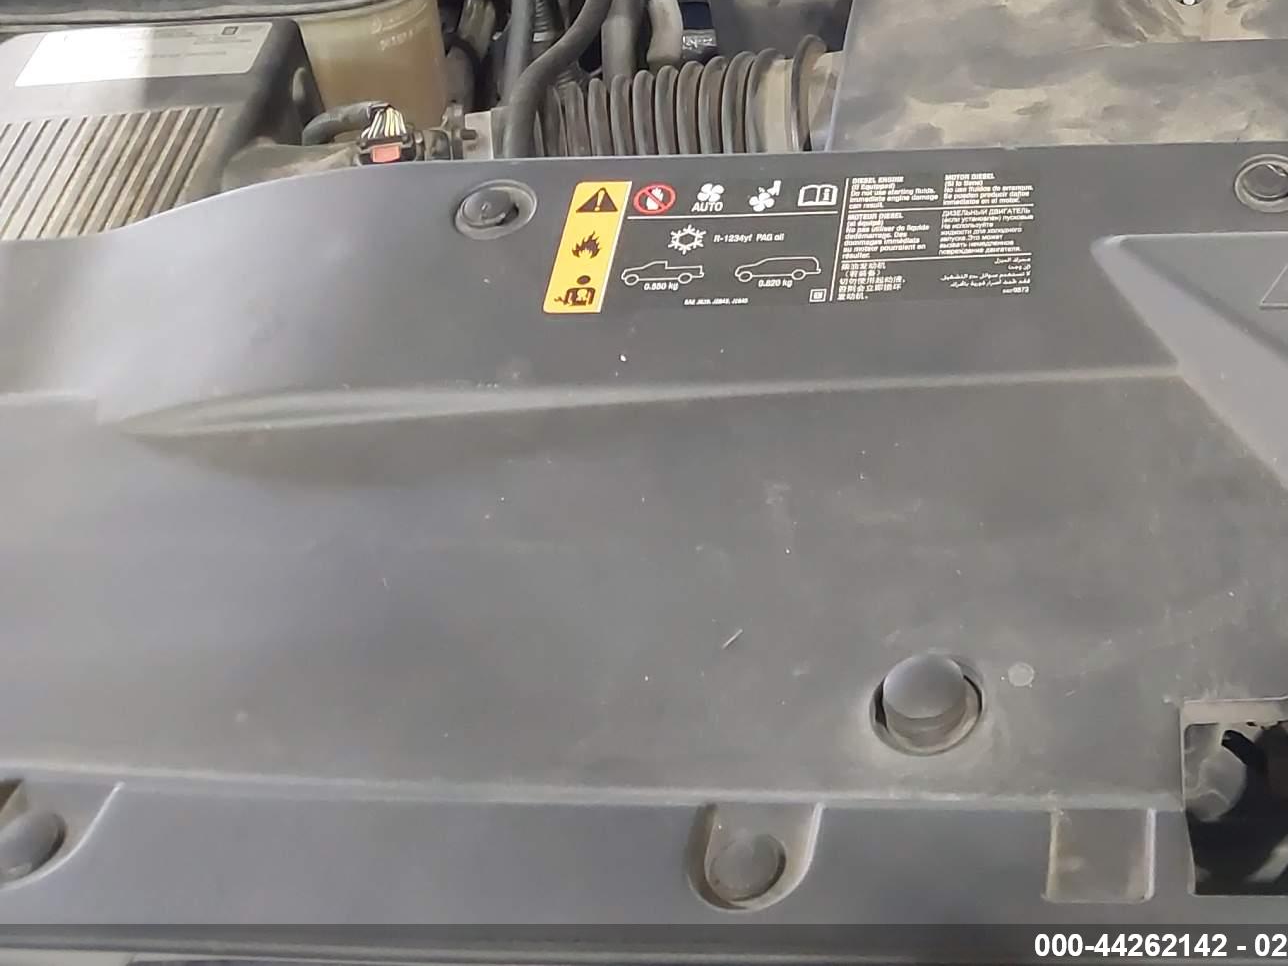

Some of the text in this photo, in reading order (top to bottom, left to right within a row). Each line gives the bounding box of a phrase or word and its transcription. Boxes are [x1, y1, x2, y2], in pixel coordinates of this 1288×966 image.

[691, 201, 724, 213] AUTO
[713, 233, 785, 243] R-1234yf PAG oil
[668, 281, 679, 291] kg
[782, 278, 793, 288] kg
